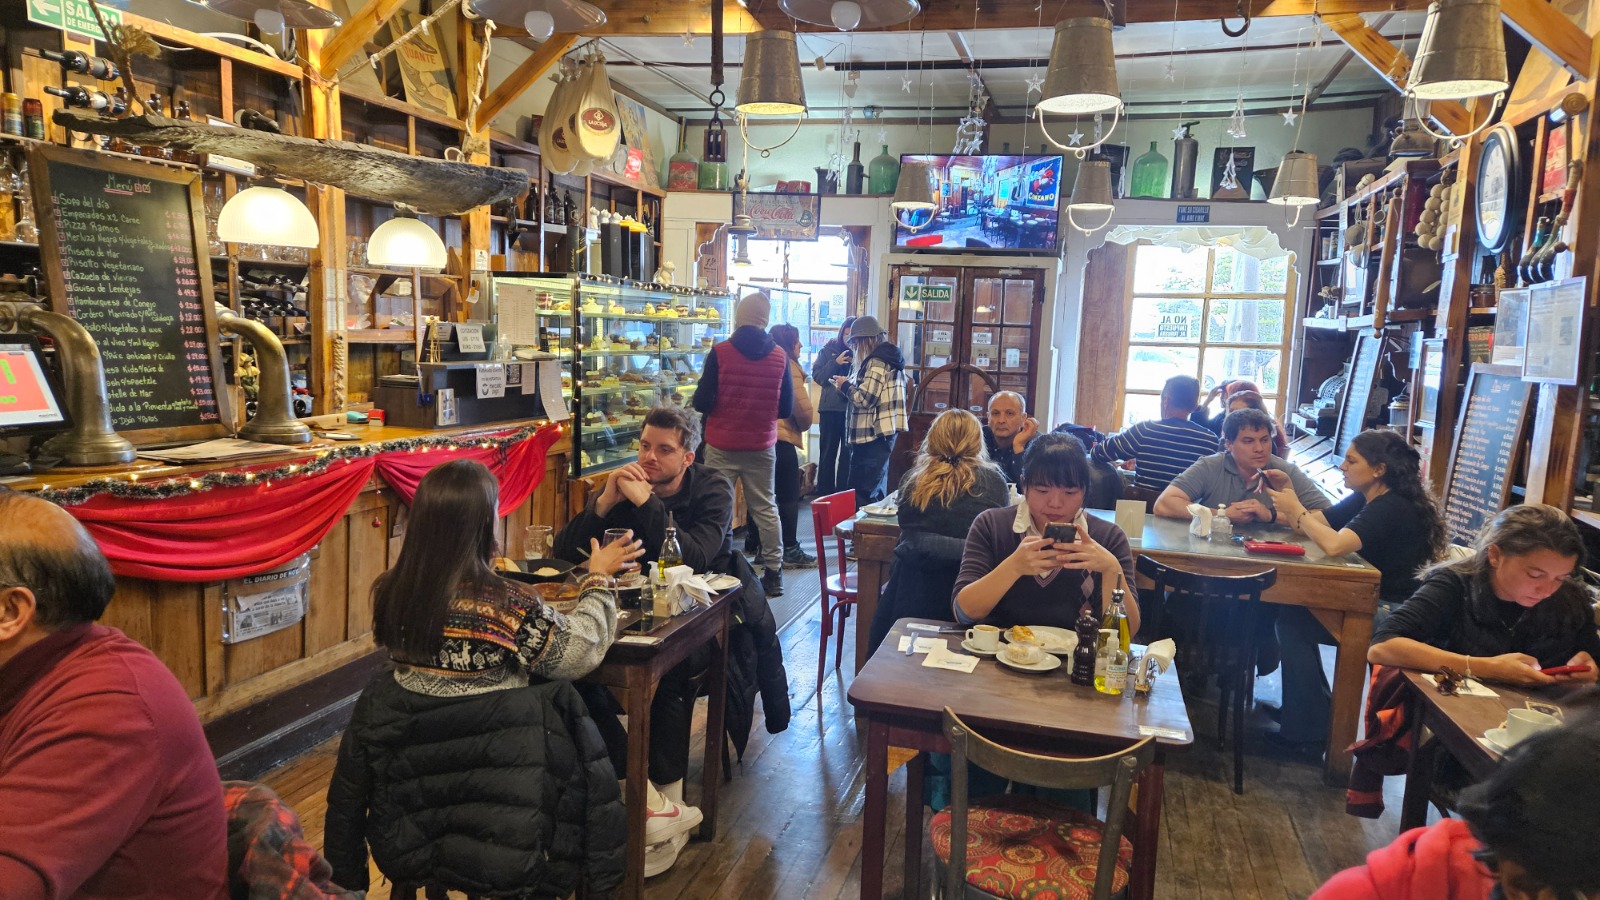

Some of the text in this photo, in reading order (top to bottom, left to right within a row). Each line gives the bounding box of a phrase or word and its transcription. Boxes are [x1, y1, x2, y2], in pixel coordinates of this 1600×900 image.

[65, 1, 117, 26] SALDA
[67, 17, 76, 26] DE
[60, 193, 80, 206] Sopa
[83, 195, 93, 207] del
[62, 208, 105, 220] Empanadas
[121, 214, 140, 225] Carne
[63, 219, 120, 234] Pizza Ramos
[66, 231, 95, 242] Merluza
[98, 233, 117, 247] Negra
[66, 245, 95, 256] Risotto
[97, 247, 104, 257] de
[68, 257, 144, 272] Risotto Vegetariano
[71, 270, 100, 280] Cazuela
[102, 271, 110, 280] de
[73, 282, 141, 297] Guiso de Lentejas
[921, 289, 949, 299] SALIDA
[75, 296, 157, 311] Hamburguesa de Conejo
[77, 308, 103, 319] Cordero
[106, 378, 120, 387] ash
[140, 389, 154, 398] Mar
[109, 402, 126, 412] diola
[254, 574, 279, 583] DIARIO
